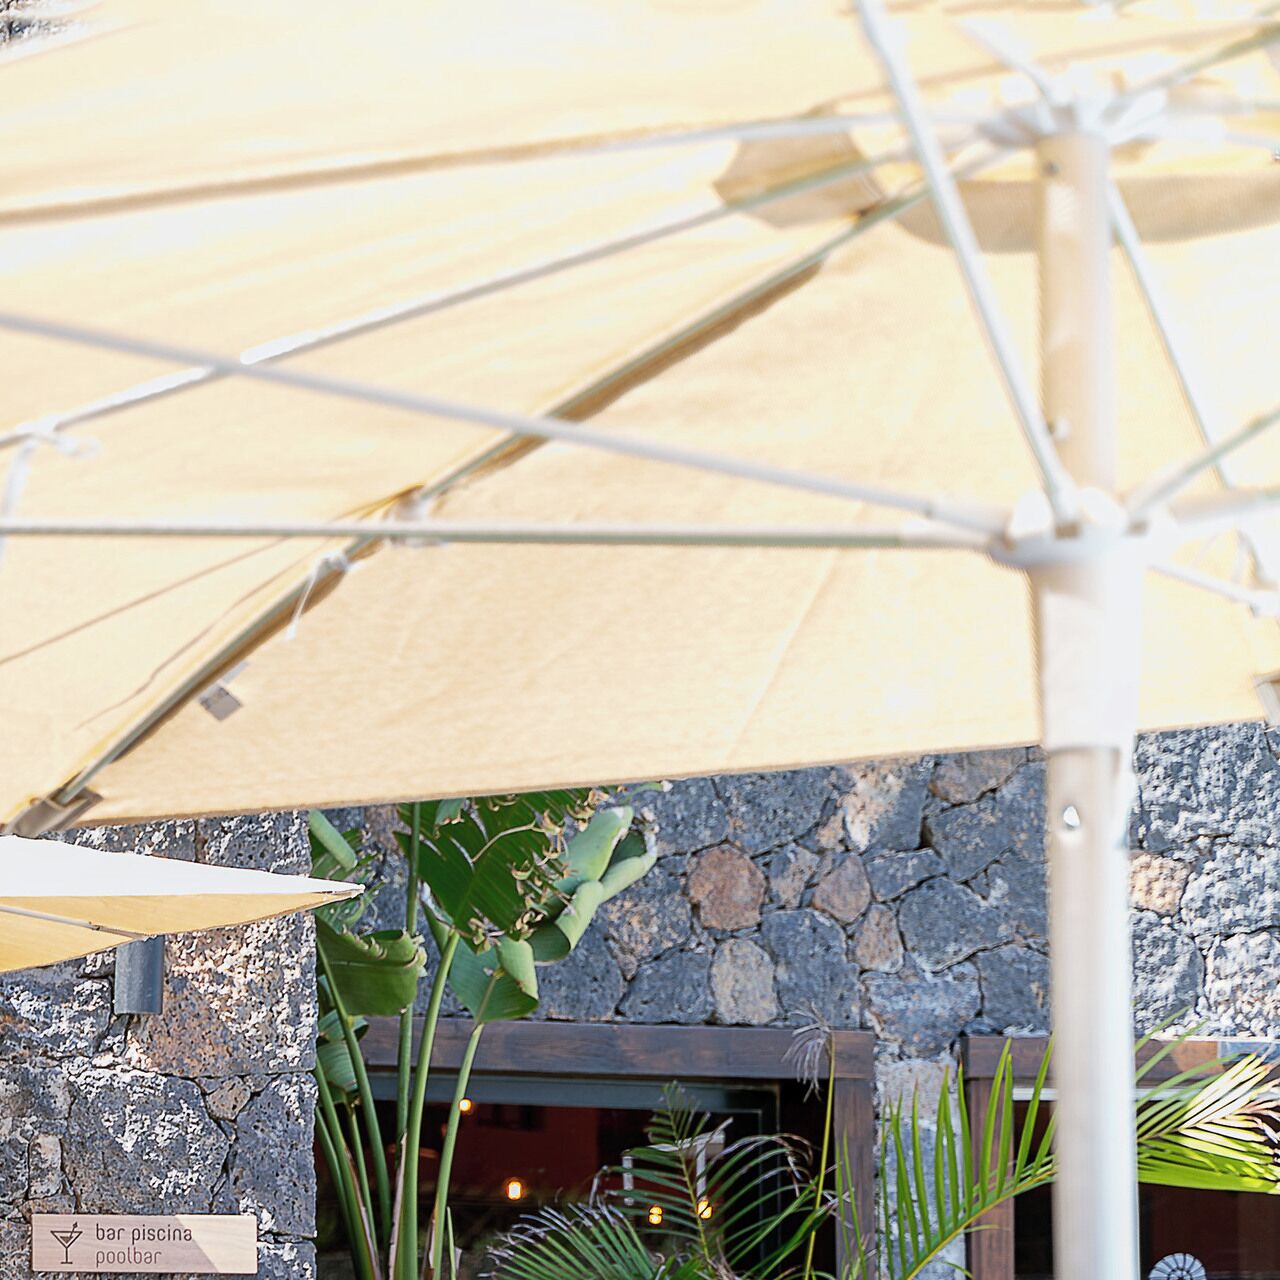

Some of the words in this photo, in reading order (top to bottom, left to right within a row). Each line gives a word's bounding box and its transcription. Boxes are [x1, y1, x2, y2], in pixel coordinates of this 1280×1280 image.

[95, 1223, 126, 1242] bar
[131, 1223, 194, 1246] piscina
[95, 1247, 163, 1269] poolbar
